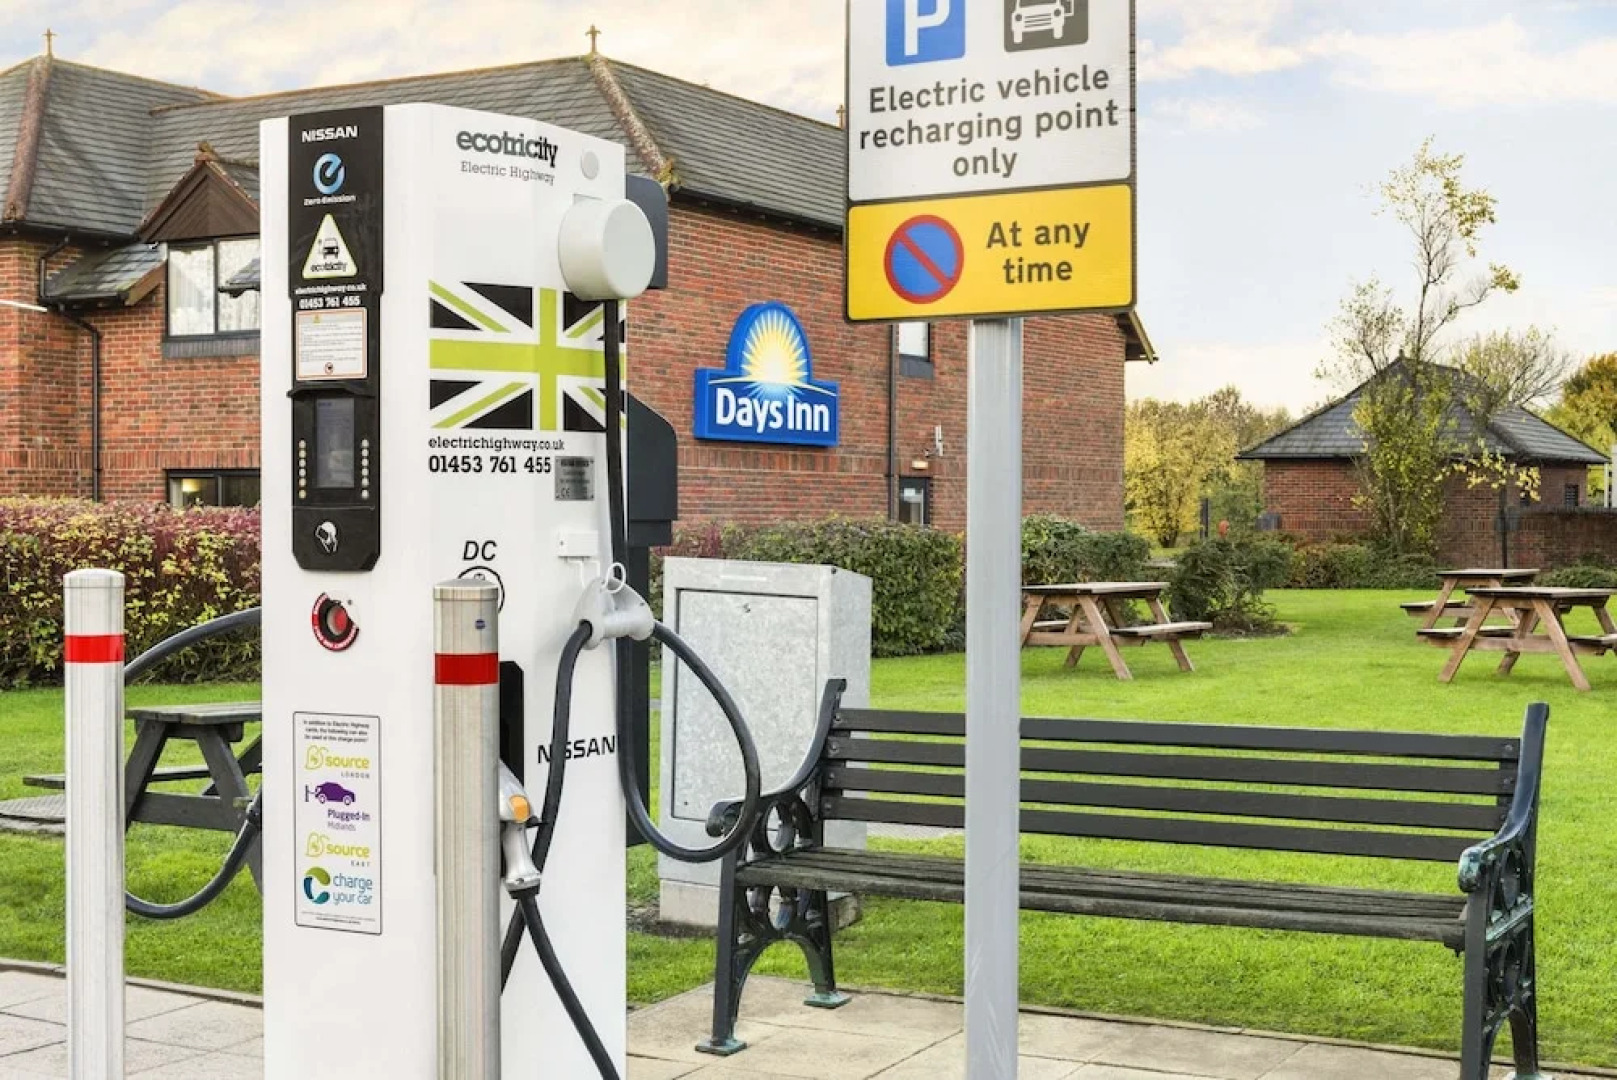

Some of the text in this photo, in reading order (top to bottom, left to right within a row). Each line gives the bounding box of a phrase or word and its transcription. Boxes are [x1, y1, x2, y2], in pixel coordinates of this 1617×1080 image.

[869, 64, 1110, 114] Electric vehicle
[301, 125, 358, 143] NISSAN
[860, 99, 1119, 150] recharging point
[456, 130, 559, 168] ecotricity
[460, 161, 556, 187] Electric Highway
[952, 147, 1018, 179] only
[985, 220, 1091, 250] At any
[1003, 256, 1073, 285] time
[342, 295, 361, 307] 455
[715, 387, 830, 434] Days Inn
[428, 436, 565, 452] electrichighway.co.uk
[428, 455, 483, 474] 01453
[489, 455, 517, 474] 761
[523, 456, 551, 474] 455
[461, 540, 498, 562] DC
[537, 735, 616, 764] NSSAN
[325, 755, 370, 769] source
[327, 808, 371, 822] Plugged-In
[326, 843, 370, 858] source
[332, 872, 373, 893] charge
[332, 892, 373, 906] your car
